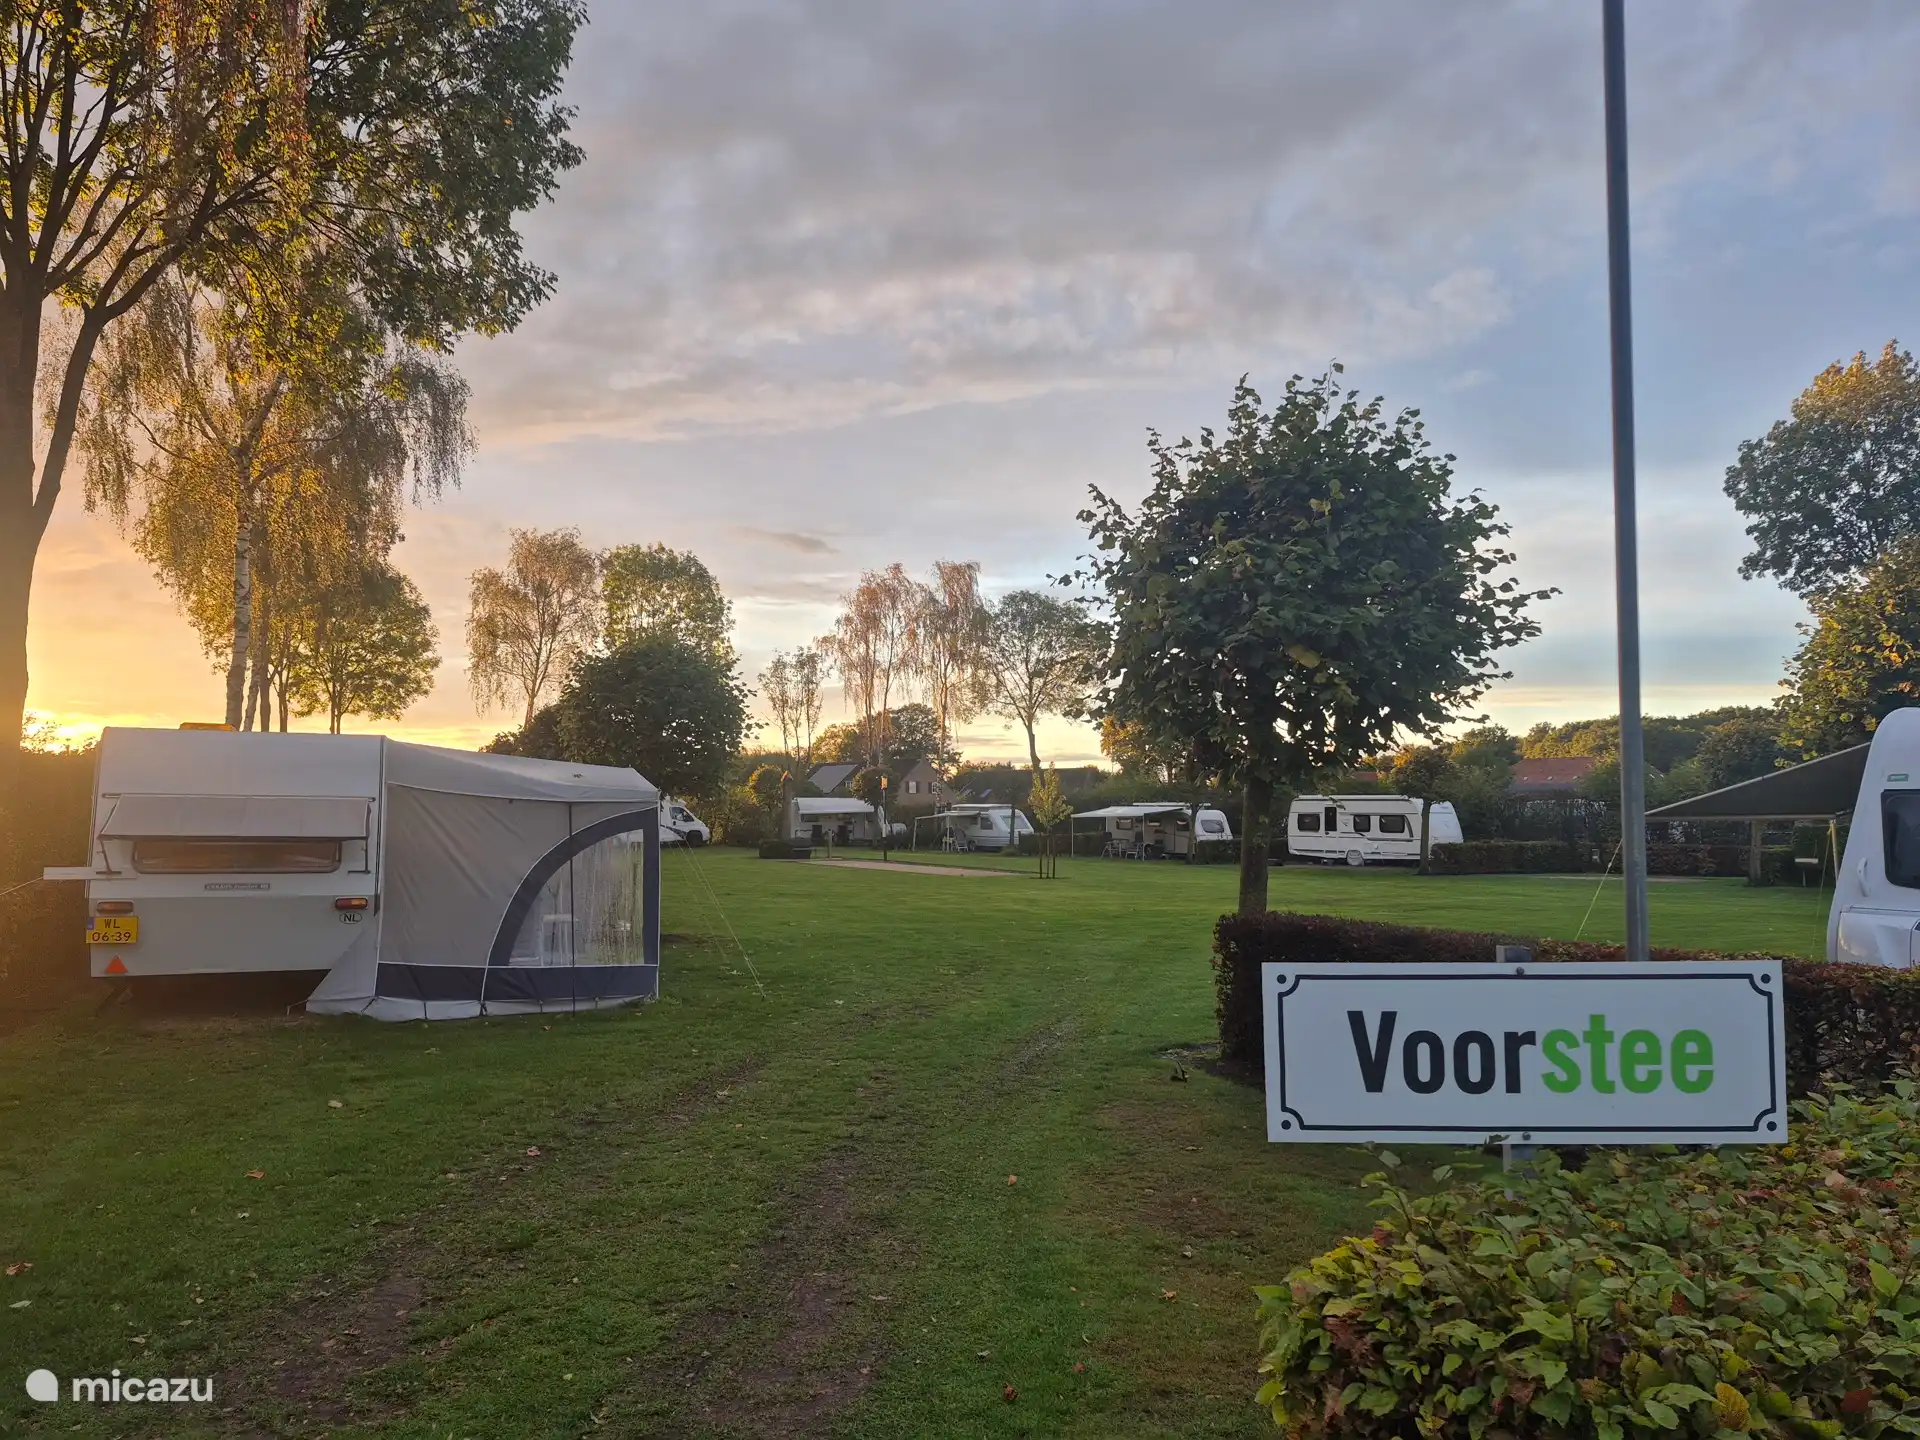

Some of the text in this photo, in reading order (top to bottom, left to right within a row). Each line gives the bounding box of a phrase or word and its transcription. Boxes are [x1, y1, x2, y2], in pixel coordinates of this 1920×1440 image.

[343, 913, 358, 922] NL
[104, 918, 121, 929] WL
[91, 931, 132, 942] 06-39
[1346, 1010, 1715, 1095] Voorstee
